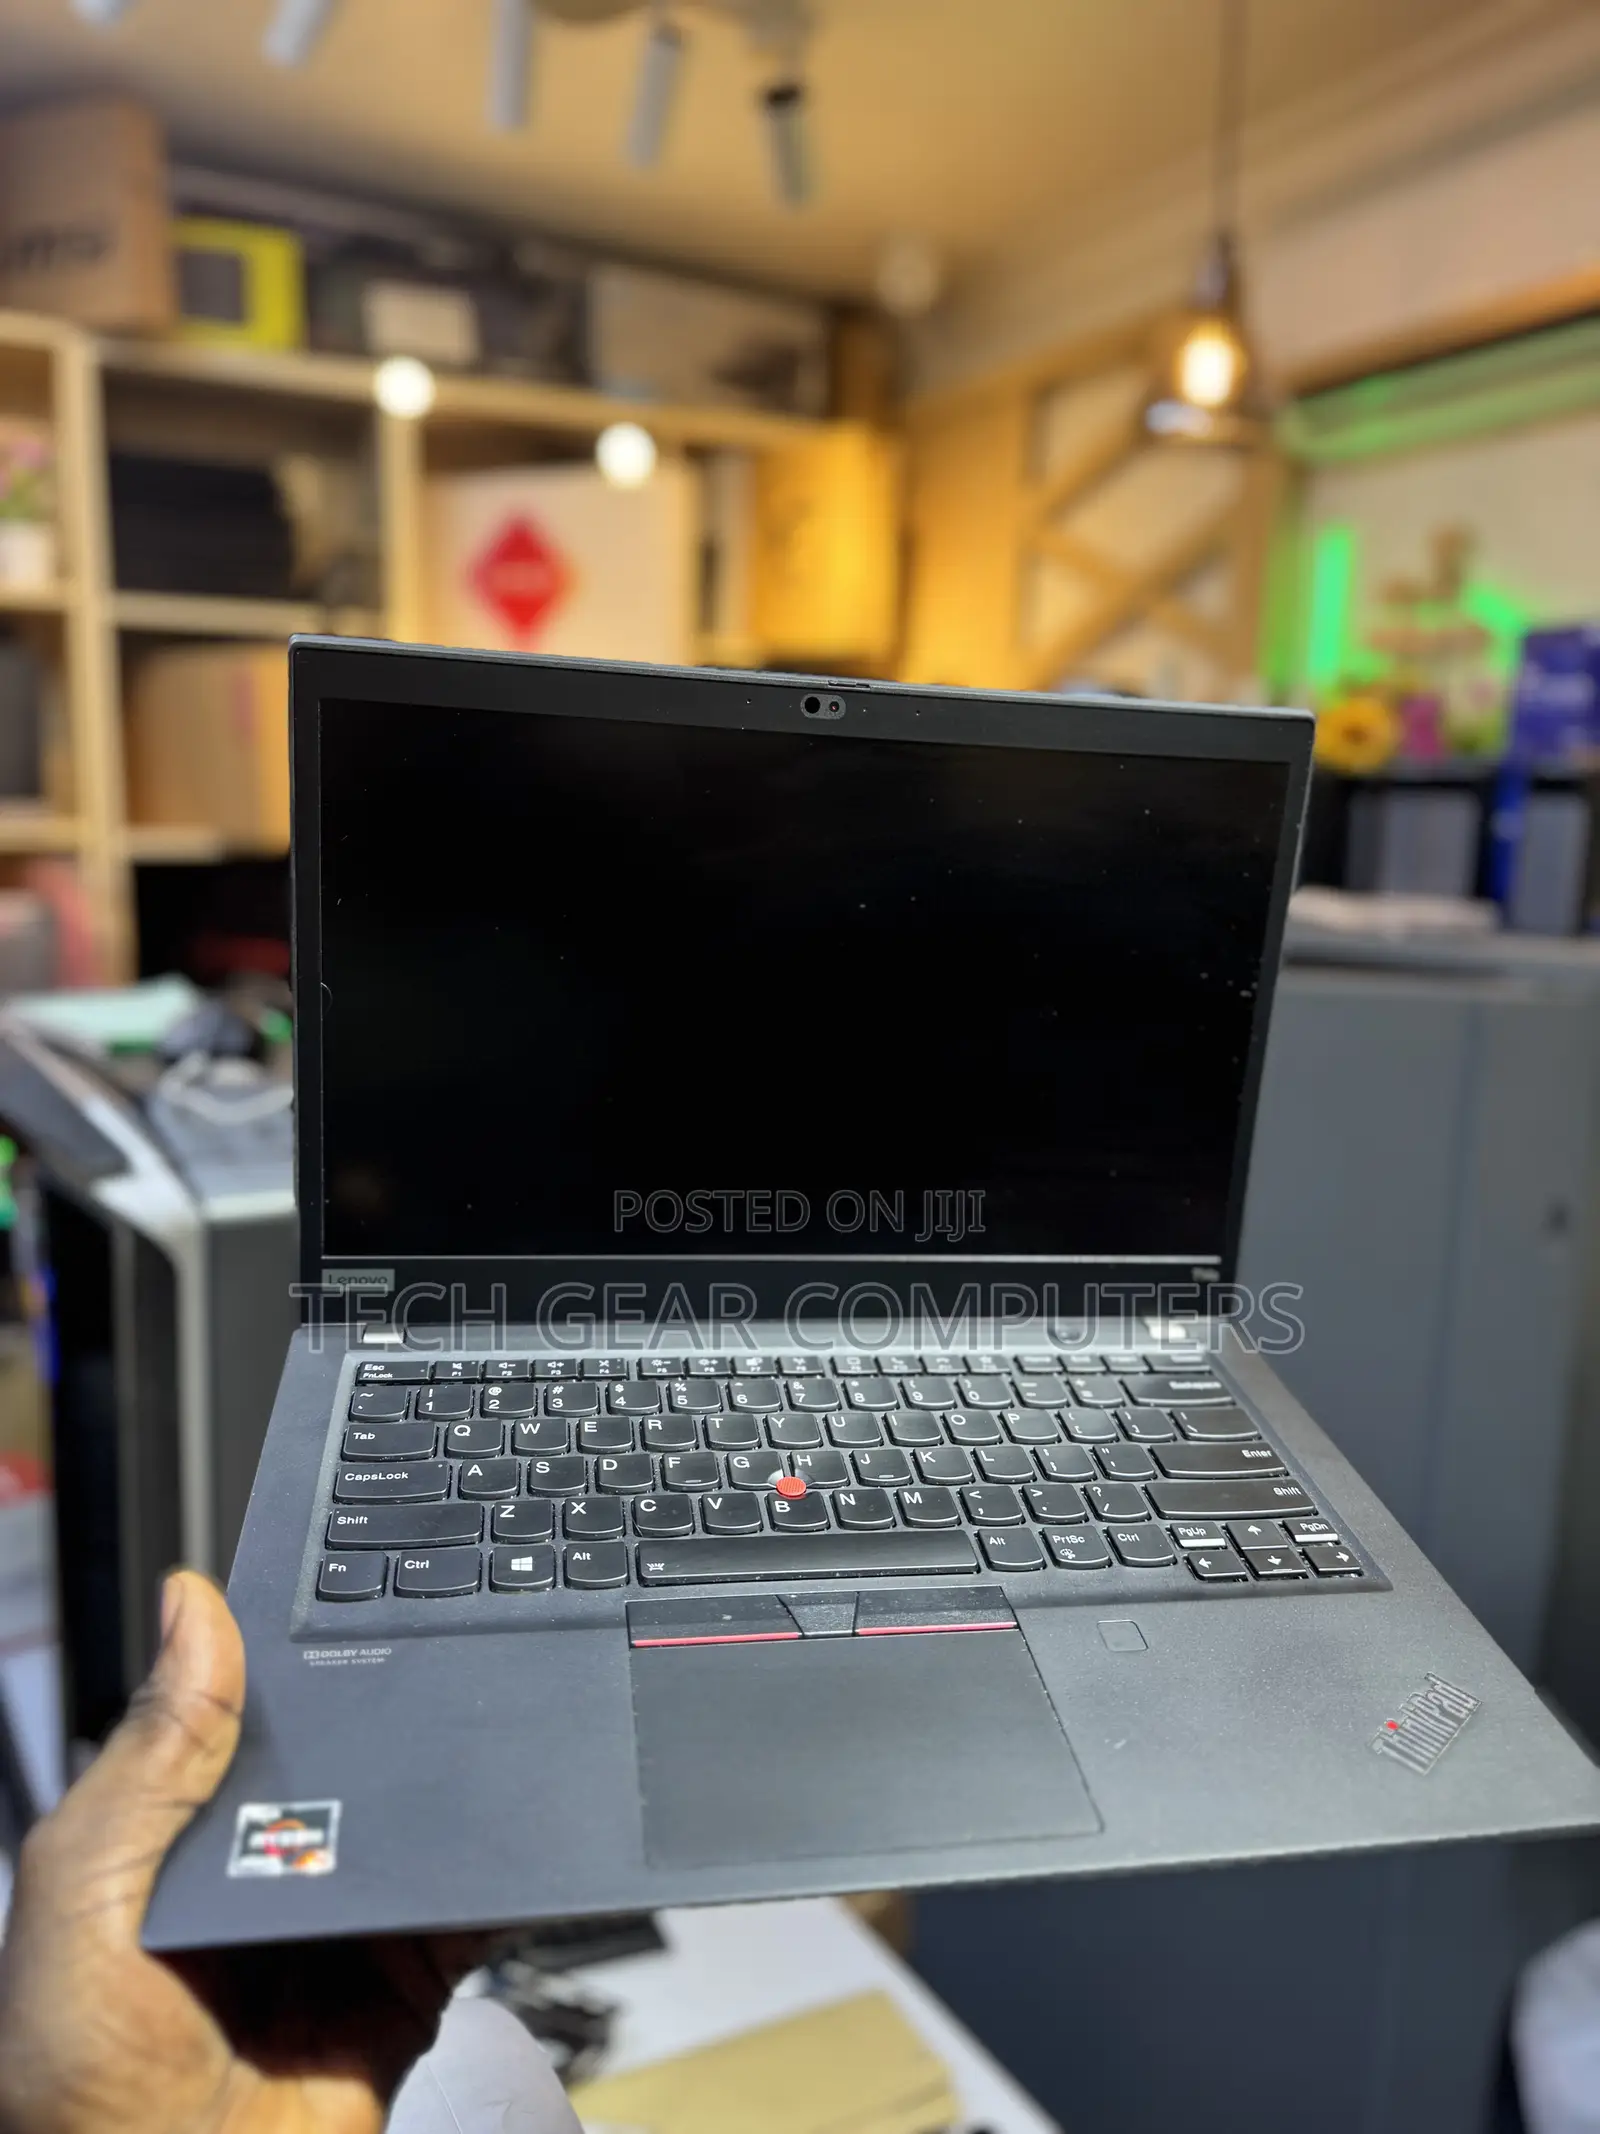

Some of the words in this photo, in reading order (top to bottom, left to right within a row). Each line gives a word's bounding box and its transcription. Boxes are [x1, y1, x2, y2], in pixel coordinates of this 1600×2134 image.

[328, 1274, 388, 1285] Lenovo
[364, 1363, 385, 1372] Esc
[451, 1369, 462, 1377] F1
[362, 1371, 393, 1379] FnLock
[488, 1386, 502, 1396] @
[552, 1385, 565, 1395] #
[614, 1384, 625, 1393] $
[674, 1382, 687, 1392] %
[614, 1397, 627, 1407] 4
[677, 1395, 688, 1405] 5
[736, 1394, 748, 1404] 6
[795, 1393, 806, 1403] 7
[854, 1392, 865, 1403] 8
[912, 1392, 924, 1401] 9
[425, 1401, 433, 1412] 1
[488, 1399, 500, 1410] 2
[552, 1398, 564, 1409] 3
[710, 1418, 724, 1429] T
[771, 1417, 786, 1428] Y
[831, 1416, 847, 1428] U
[890, 1415, 898, 1426] I
[950, 1415, 966, 1426] O
[1007, 1413, 1020, 1424] P
[520, 1422, 541, 1435] W
[584, 1421, 597, 1433] E
[648, 1419, 663, 1430] R
[353, 1431, 376, 1440] Tab
[453, 1424, 471, 1438] Q
[920, 1451, 936, 1463] K
[981, 1451, 995, 1462] L
[1241, 1449, 1272, 1458] Enter
[602, 1459, 618, 1471] D
[668, 1457, 682, 1468] F
[733, 1456, 750, 1469] G
[796, 1455, 812, 1466] H
[860, 1454, 871, 1465] J
[467, 1464, 483, 1476] A
[535, 1461, 550, 1474] S
[344, 1471, 409, 1482] CapsLock
[969, 1490, 982, 1499] <
[1092, 1487, 1103, 1497] ?
[1273, 1486, 1301, 1496] Shift
[707, 1497, 723, 1510] V
[839, 1493, 856, 1505] N
[905, 1492, 923, 1504] M
[500, 1505, 515, 1518] Z
[571, 1501, 587, 1515] X
[640, 1500, 657, 1512] C
[775, 1501, 791, 1513] B
[336, 1515, 369, 1526] Shift
[1177, 1526, 1207, 1537] PgUp
[1299, 1522, 1329, 1531] PgDn
[988, 1536, 1006, 1546] Alt
[1052, 1534, 1085, 1545] PrtSc
[1117, 1533, 1140, 1543] Ctrl
[572, 1551, 591, 1561] Alt
[328, 1563, 347, 1572] Fn
[404, 1559, 430, 1569] Ctrl
[320, 1649, 358, 1658] DOLBY
[360, 1647, 392, 1656] AUDIO
[1366, 1671, 1482, 1776] ThinkPad
